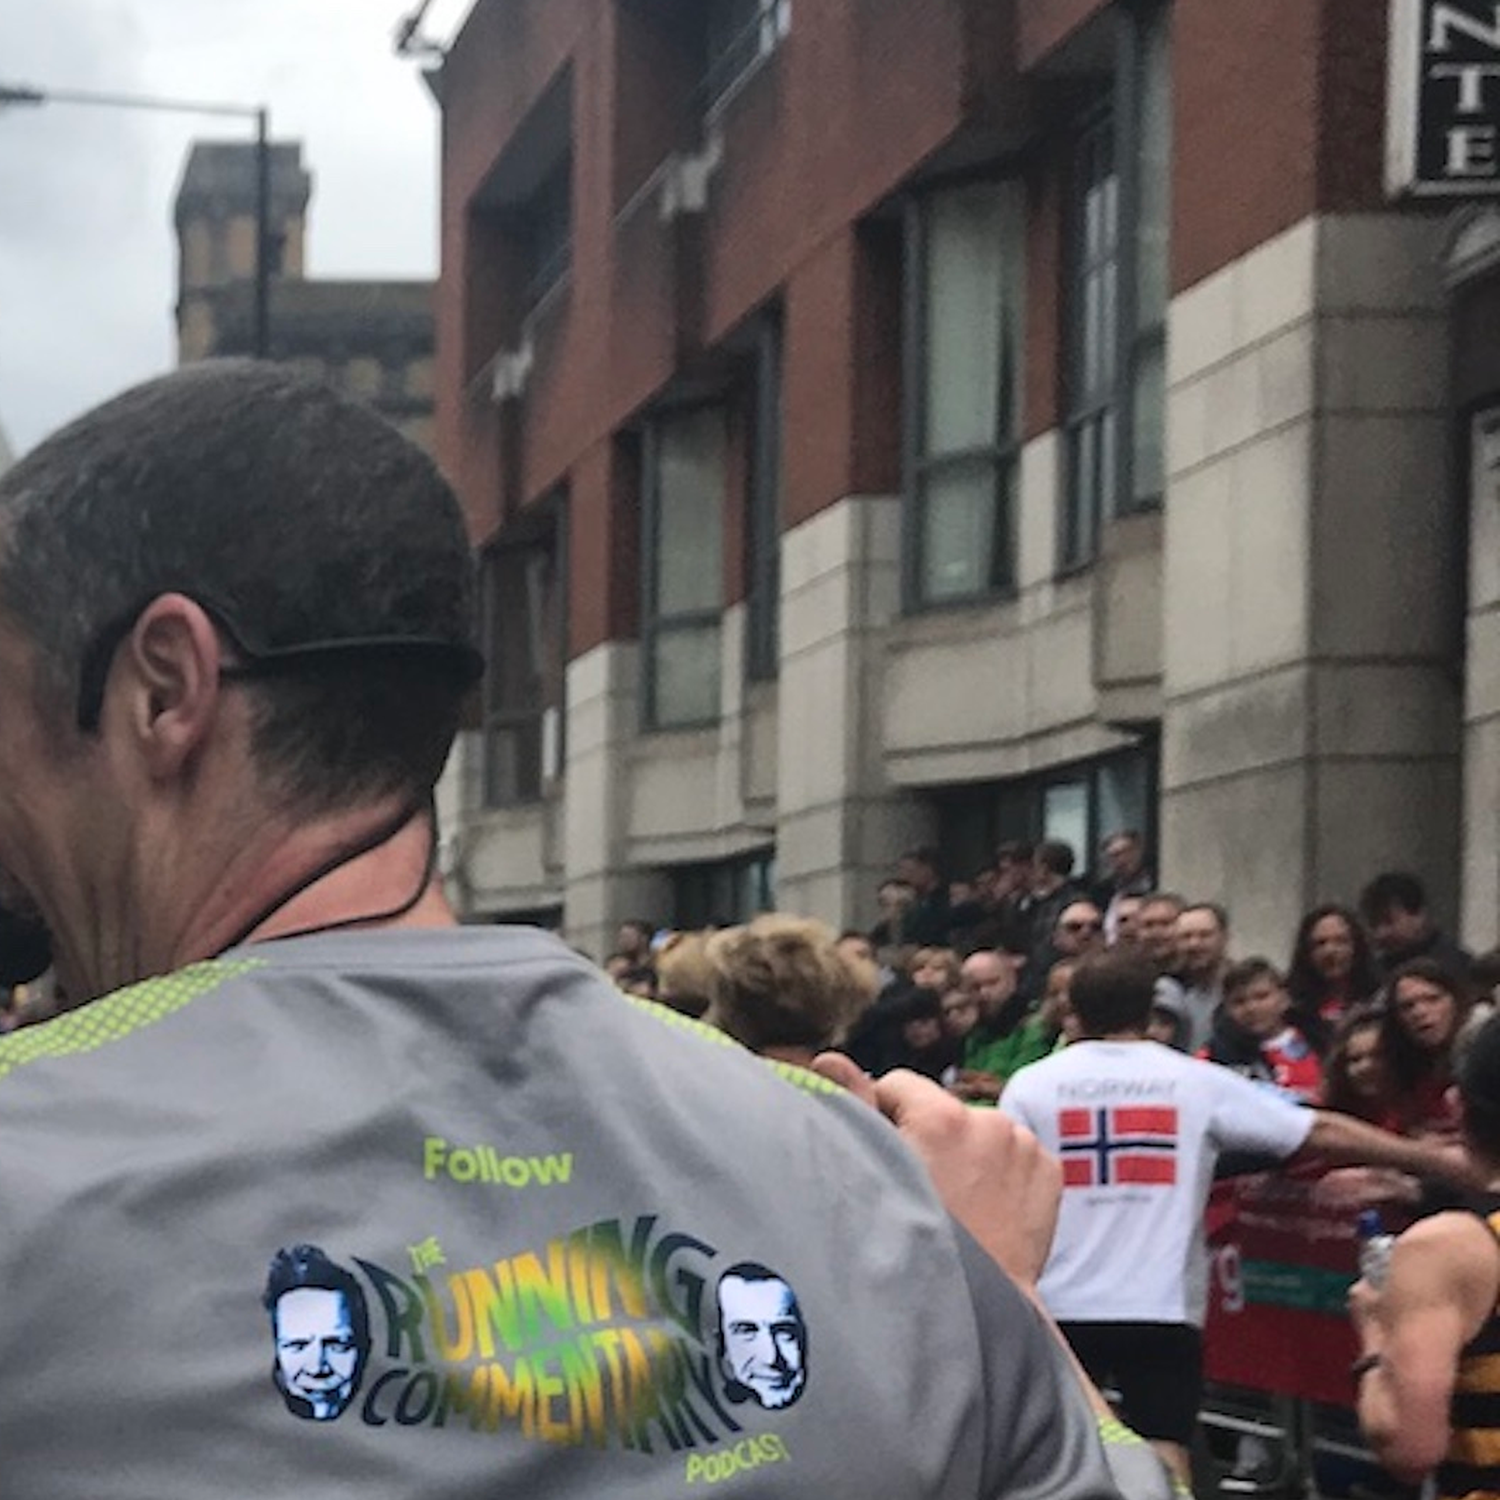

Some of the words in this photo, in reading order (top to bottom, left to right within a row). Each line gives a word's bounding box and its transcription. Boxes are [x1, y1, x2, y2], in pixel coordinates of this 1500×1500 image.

[1057, 1080, 1176, 1099] NORWAY
[424, 1137, 574, 1187] Follow
[407, 1236, 446, 1274] THE
[350, 1214, 717, 1362] RUNNING
[361, 1326, 743, 1454] COMMENTARY
